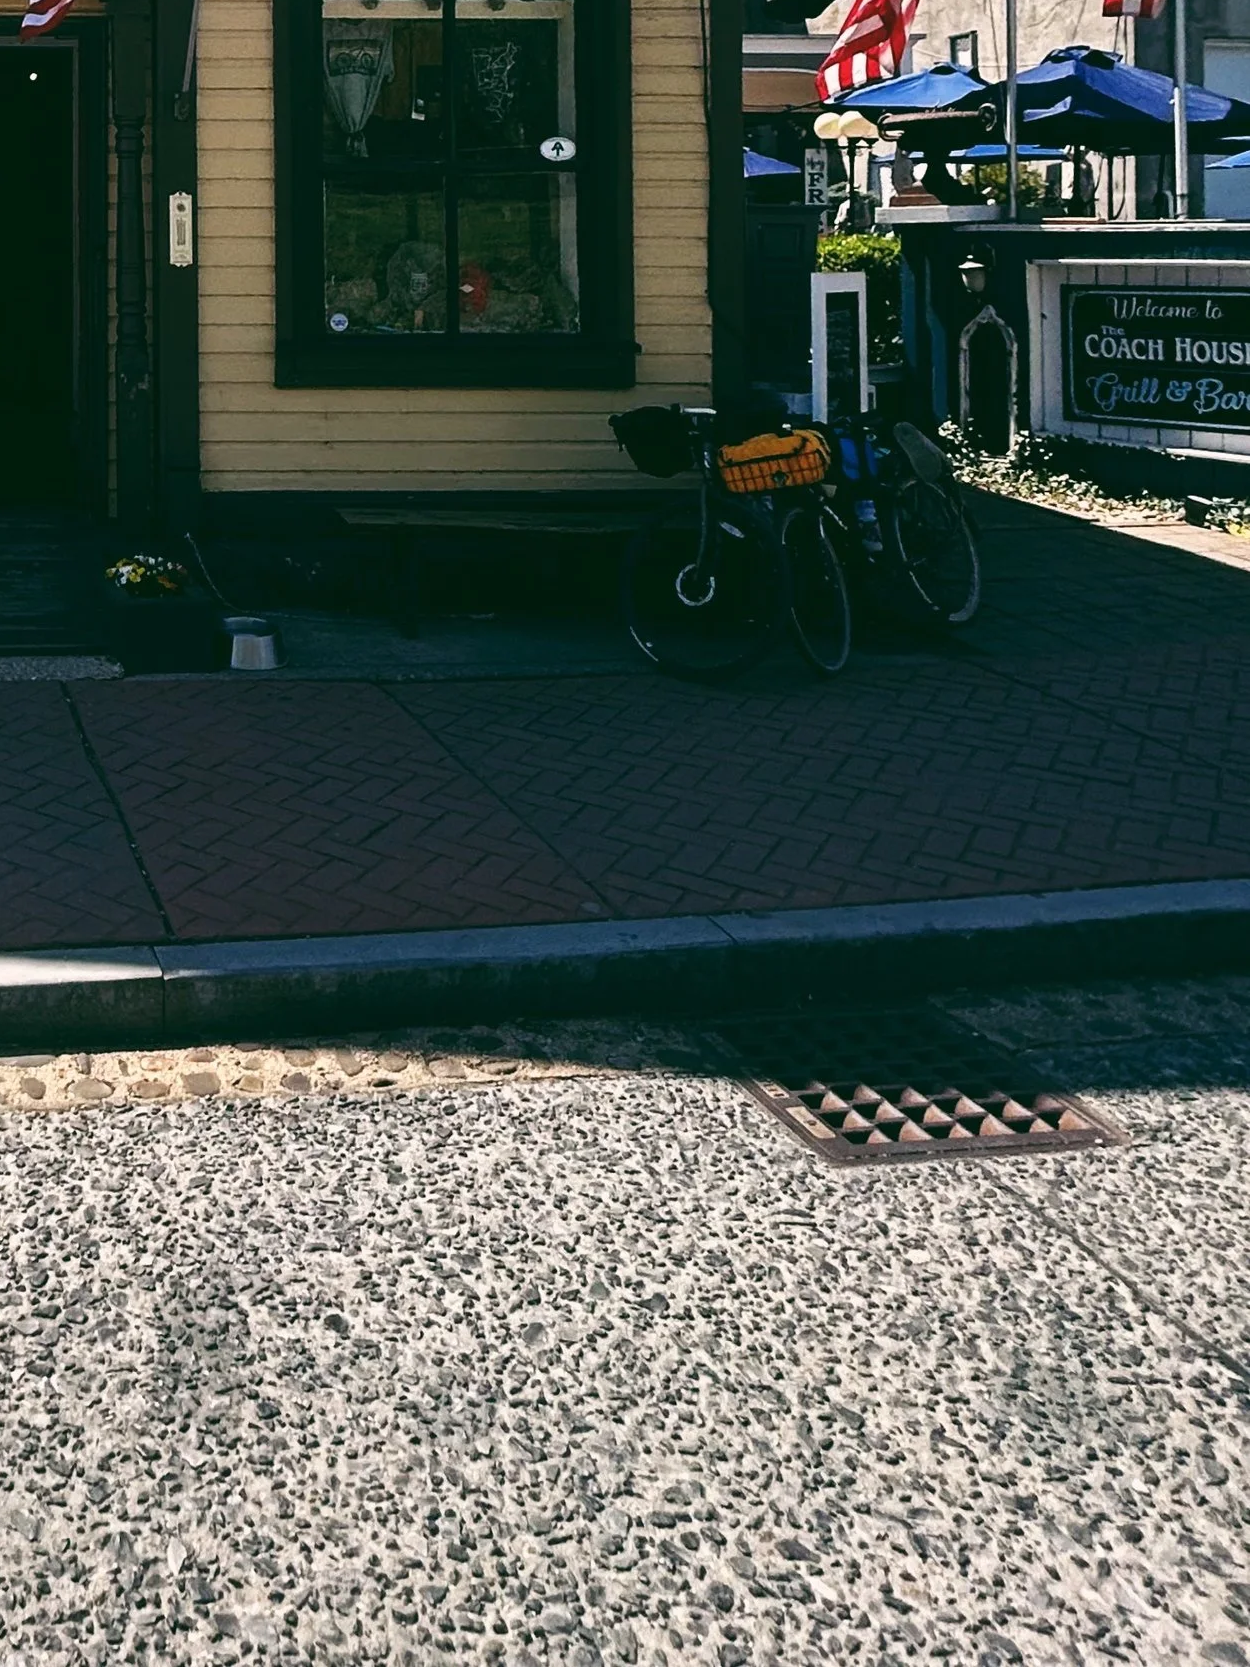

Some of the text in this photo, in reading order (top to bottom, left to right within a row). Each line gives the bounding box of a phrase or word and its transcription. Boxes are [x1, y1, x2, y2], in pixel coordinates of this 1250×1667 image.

[1106, 296, 1224, 320] Welcome to
[1085, 334, 1165, 361] COACH
[1086, 373, 1161, 411] Grill
[1166, 380, 1192, 402] &
